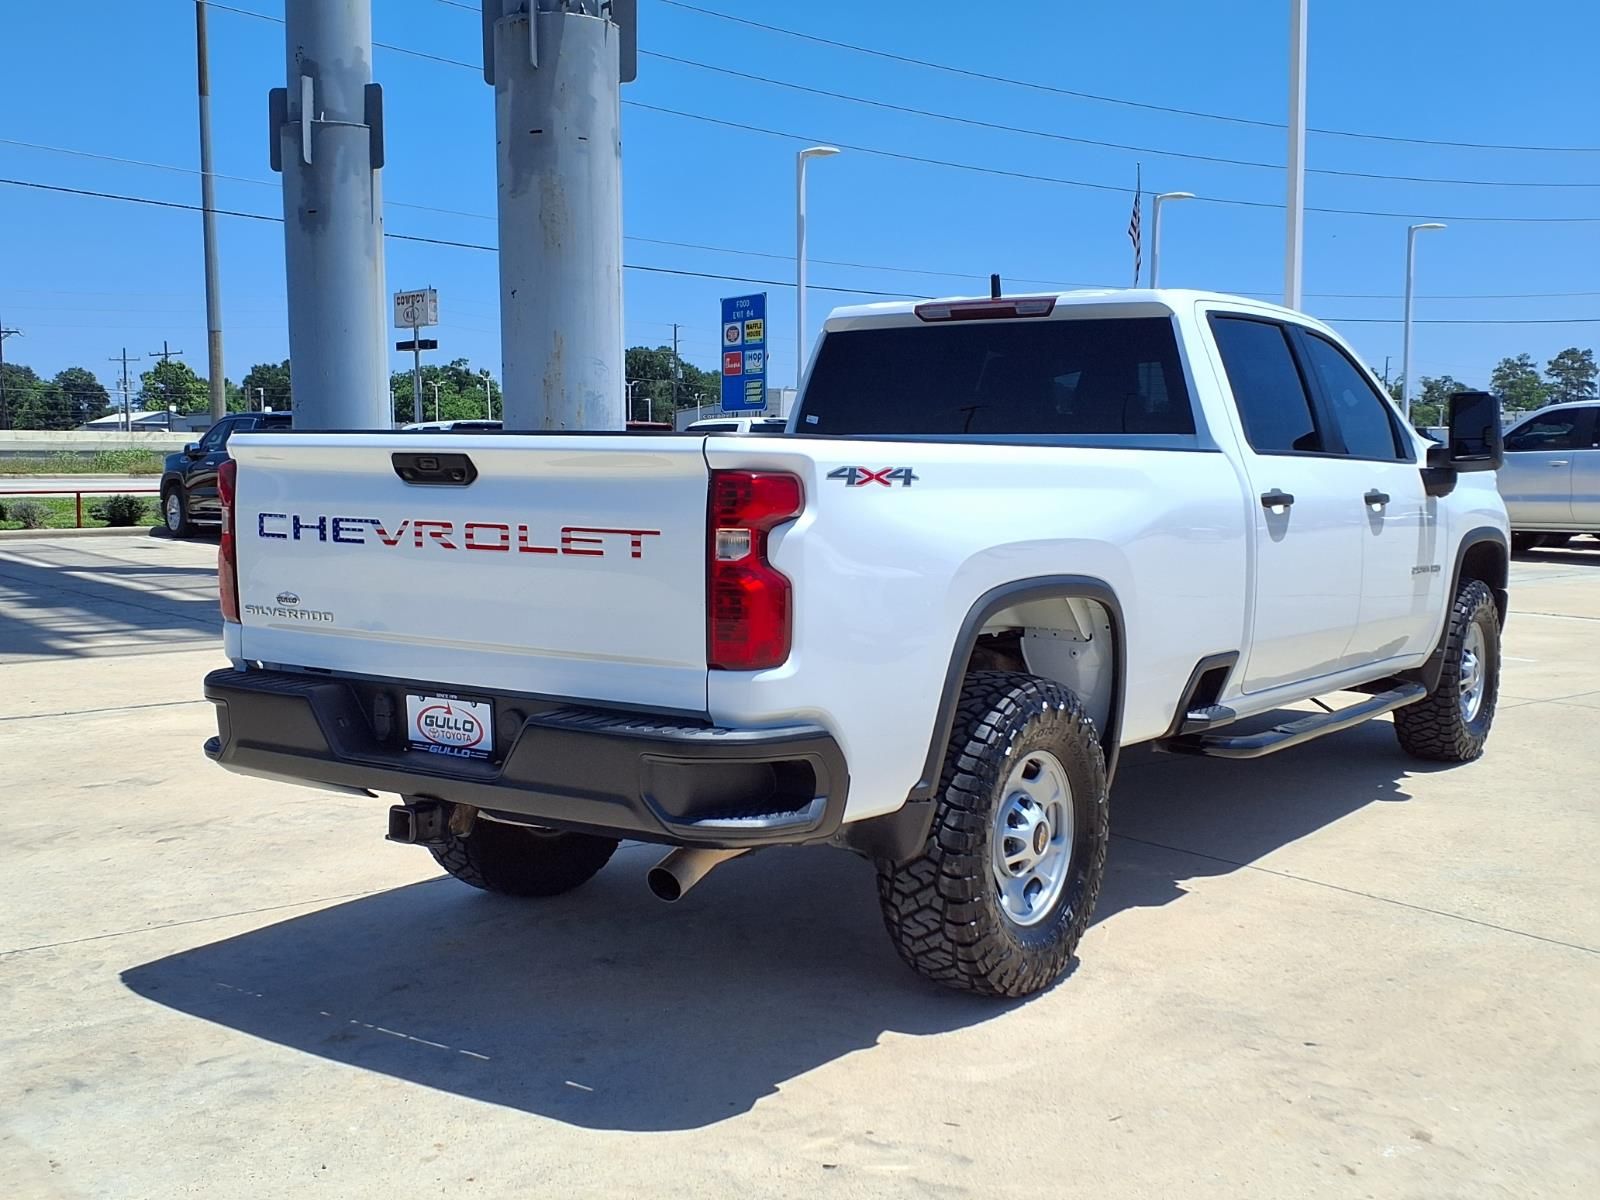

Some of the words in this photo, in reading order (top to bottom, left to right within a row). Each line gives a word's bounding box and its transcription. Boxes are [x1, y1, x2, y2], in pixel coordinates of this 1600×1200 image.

[736, 300, 750, 308] FOOD
[732, 310, 744, 320] EXIT
[746, 322, 762, 330] WAFFLE
[746, 330, 761, 338] HOUSE
[257, 512, 662, 559] CHEVROLET
[244, 603, 334, 623] SILVERADO
[424, 714, 474, 733] GULLO
[440, 730, 473, 742] TOYOTA
[429, 744, 472, 758] GULLO
